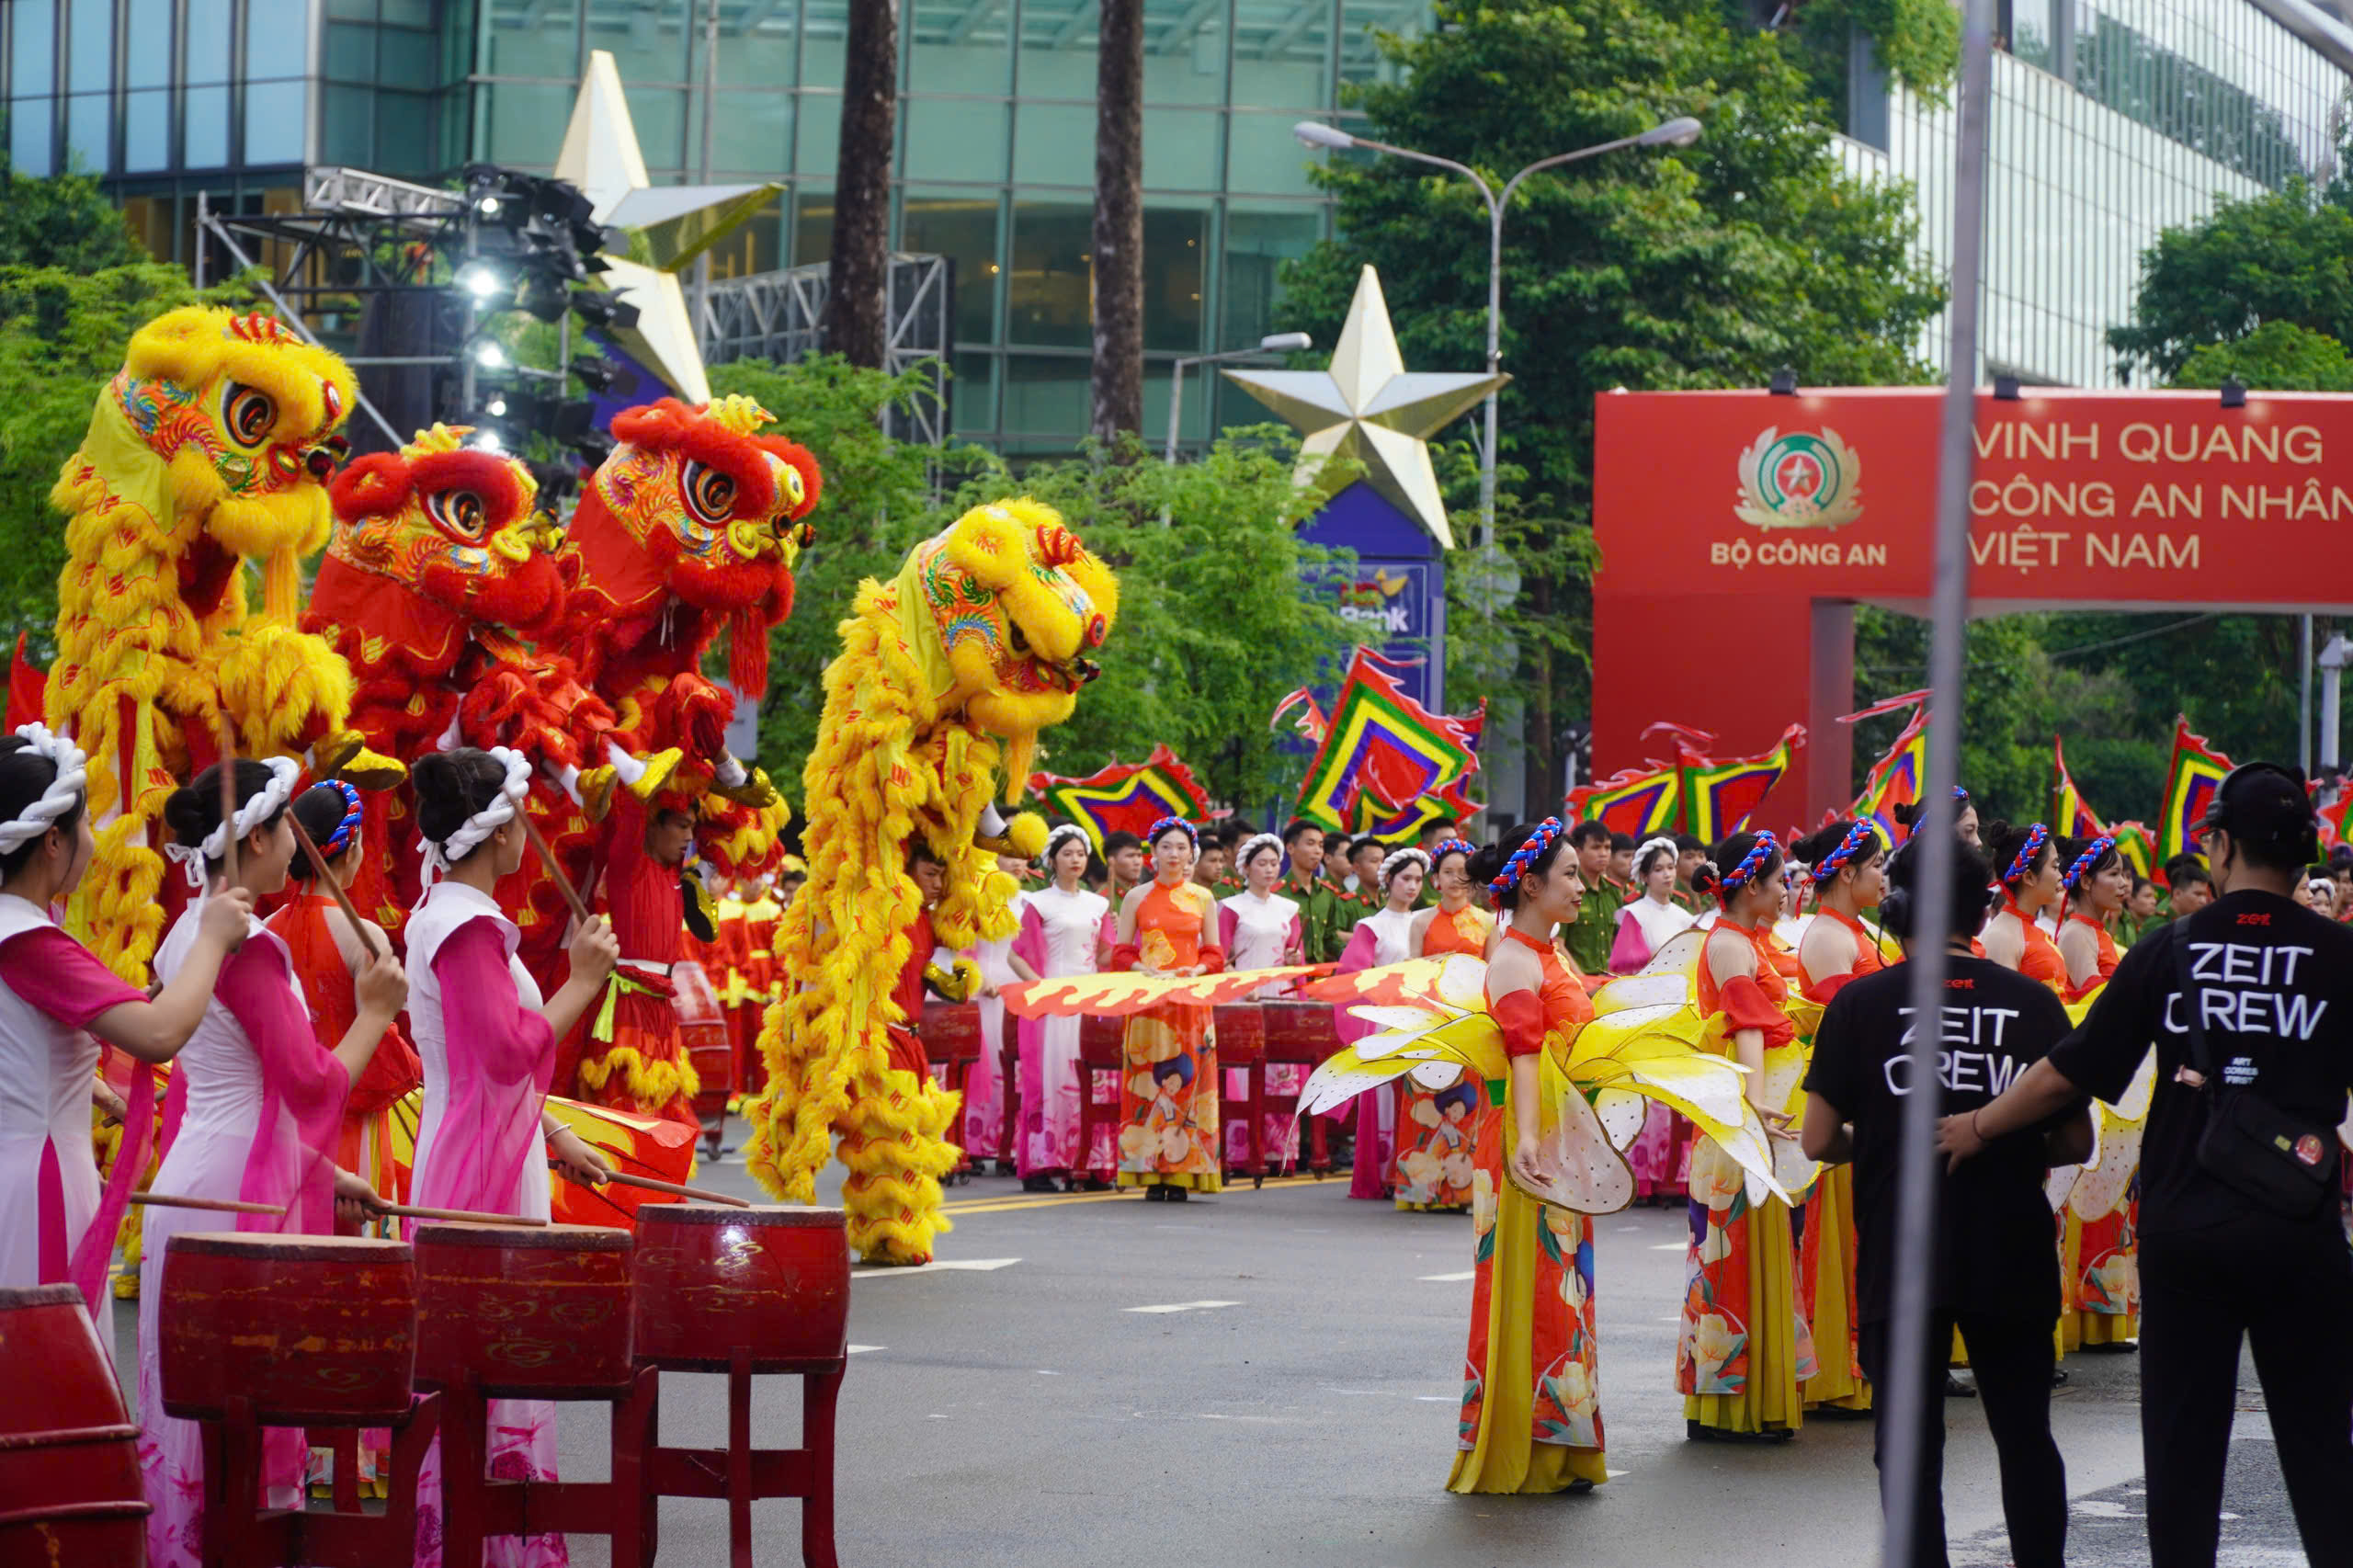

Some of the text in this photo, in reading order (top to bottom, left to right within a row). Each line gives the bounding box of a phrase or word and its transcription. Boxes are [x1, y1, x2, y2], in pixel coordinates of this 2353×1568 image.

[1972, 422, 2323, 464] VINH QUANG
[1969, 472, 2353, 521] CÔNG AN NHÂN
[1711, 538, 1887, 570] BỘ CÔNG AN
[1967, 523, 2200, 574] VIỆT NAM
[2188, 942, 2314, 985] ZEIT
[1898, 1006, 2019, 1047] ZEIT
[2164, 987, 2328, 1040] CREW
[1883, 1050, 2028, 1096] CREW
